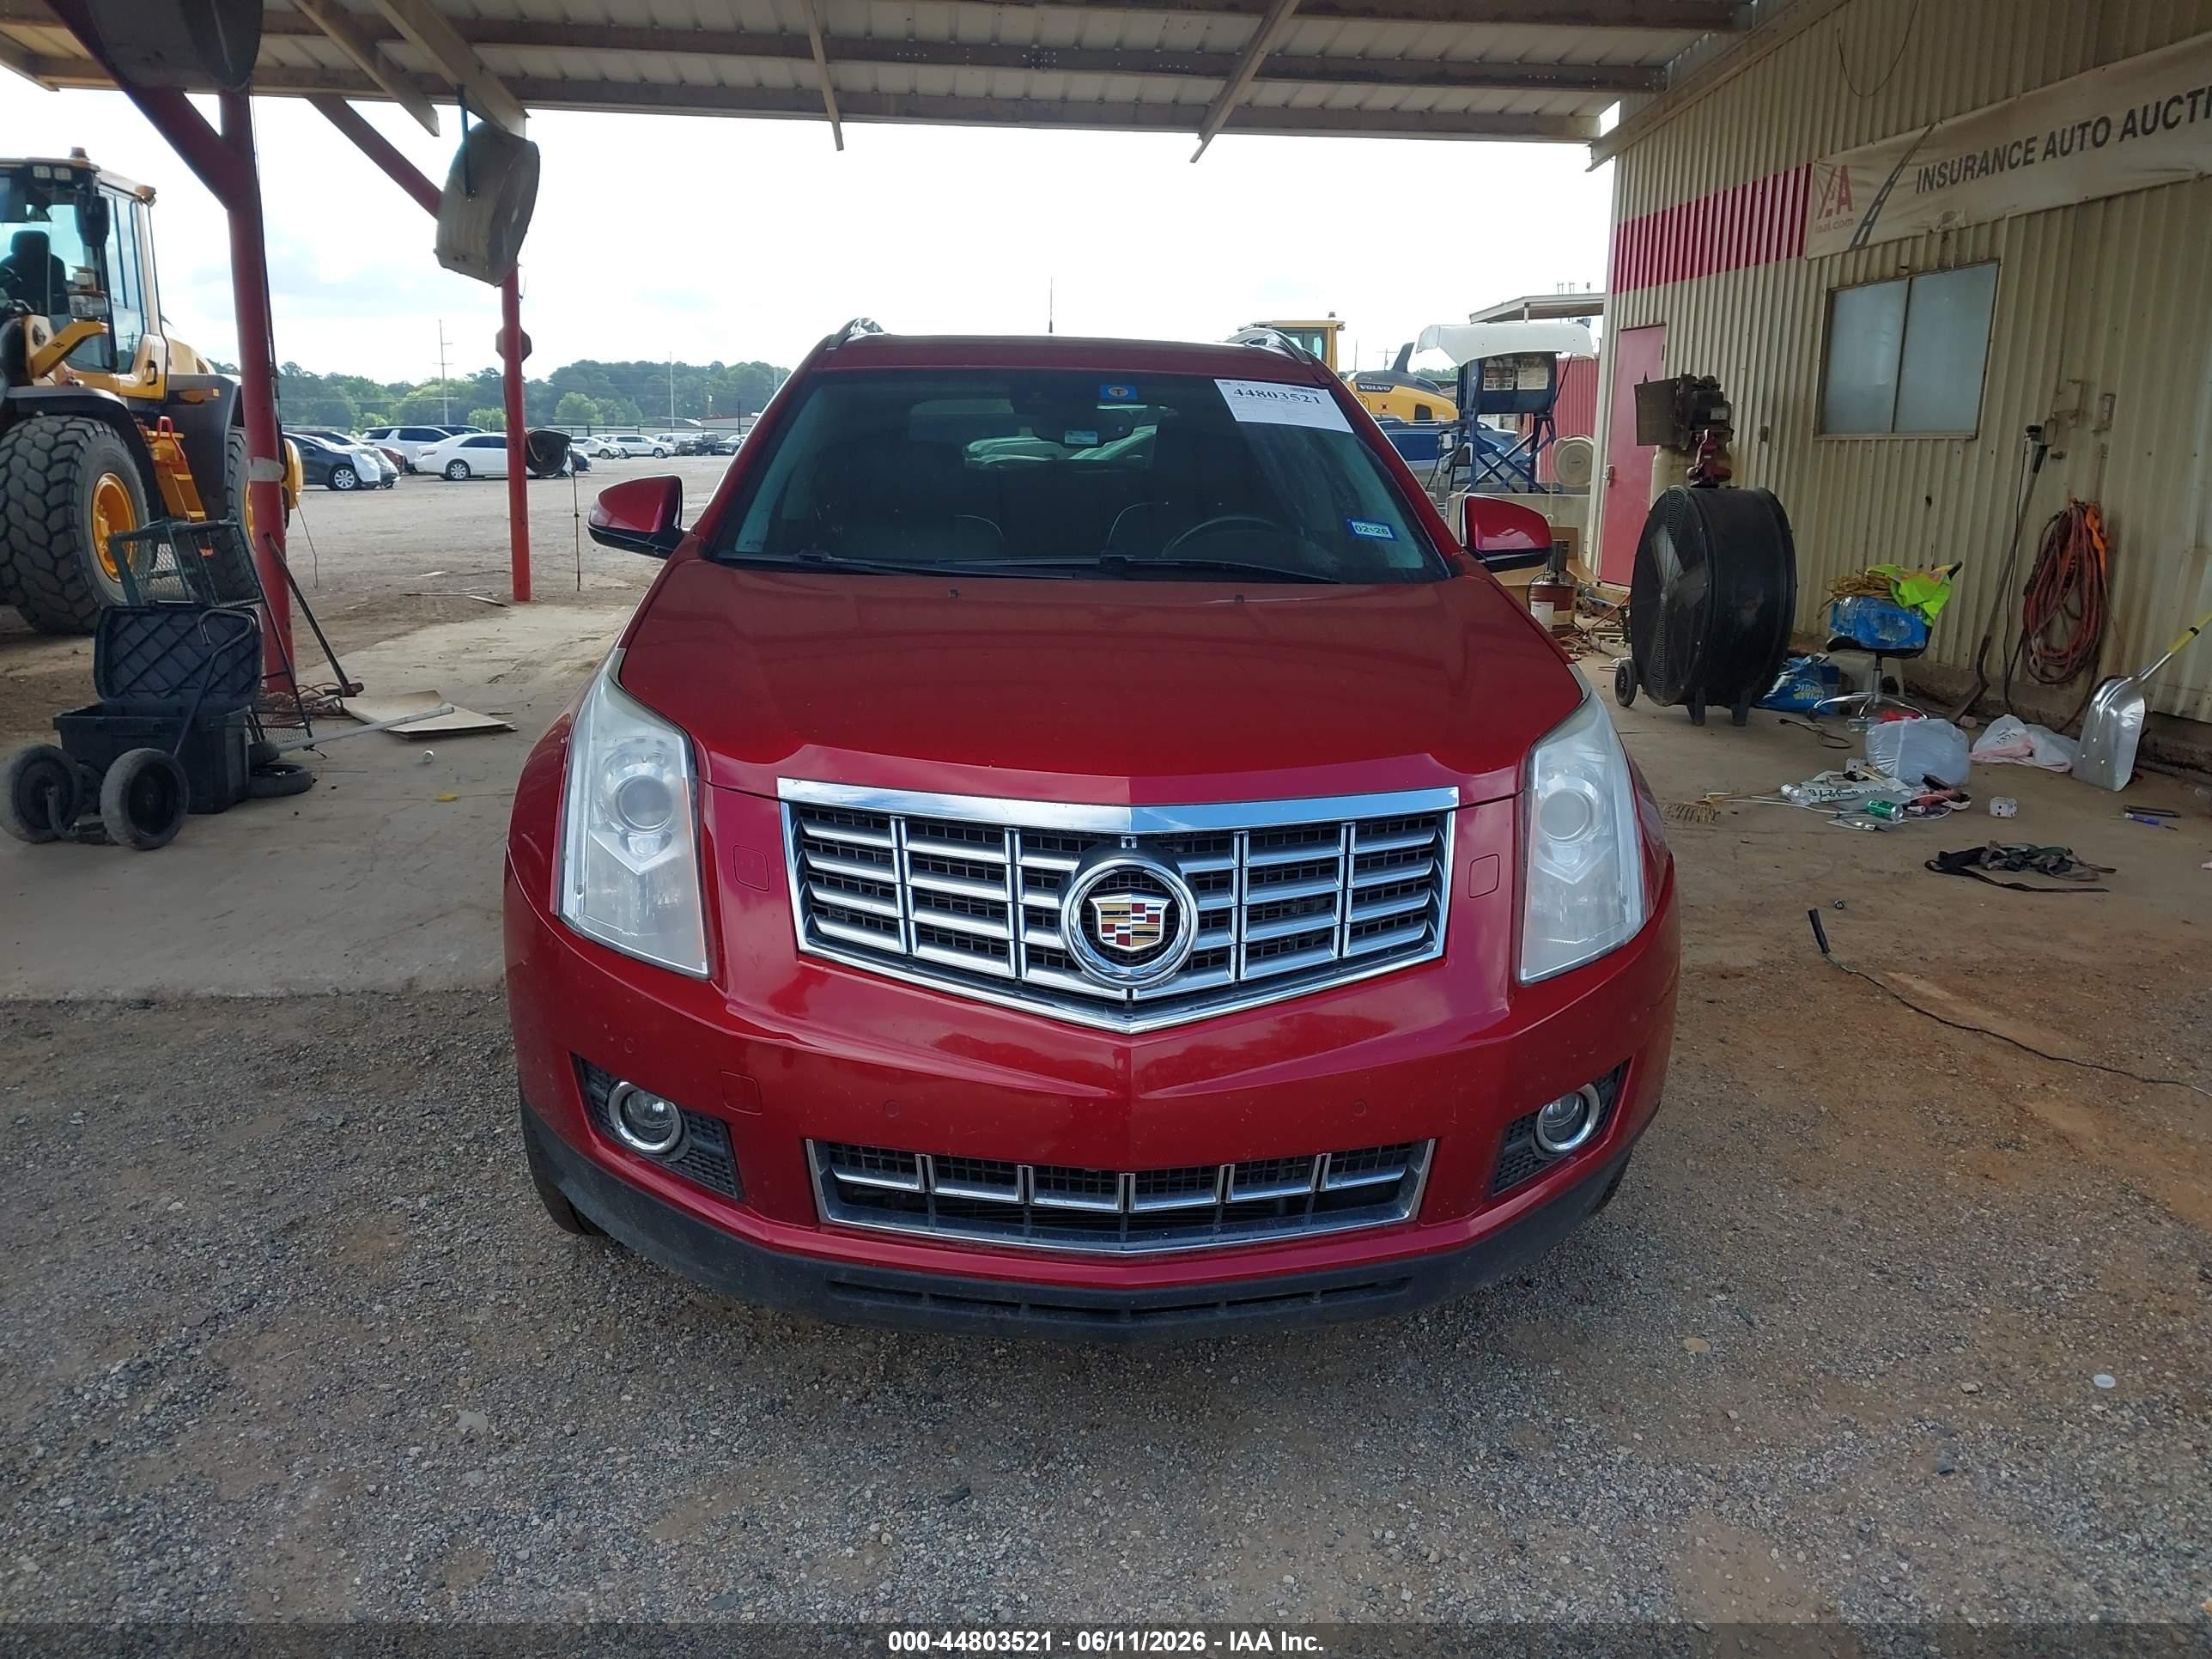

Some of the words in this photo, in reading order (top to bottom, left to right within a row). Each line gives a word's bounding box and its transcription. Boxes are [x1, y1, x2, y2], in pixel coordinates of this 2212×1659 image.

[1916, 136, 2038, 194] INSURANCE
[2041, 116, 2112, 161] AUTO
[1233, 388, 1322, 404] 44803521
